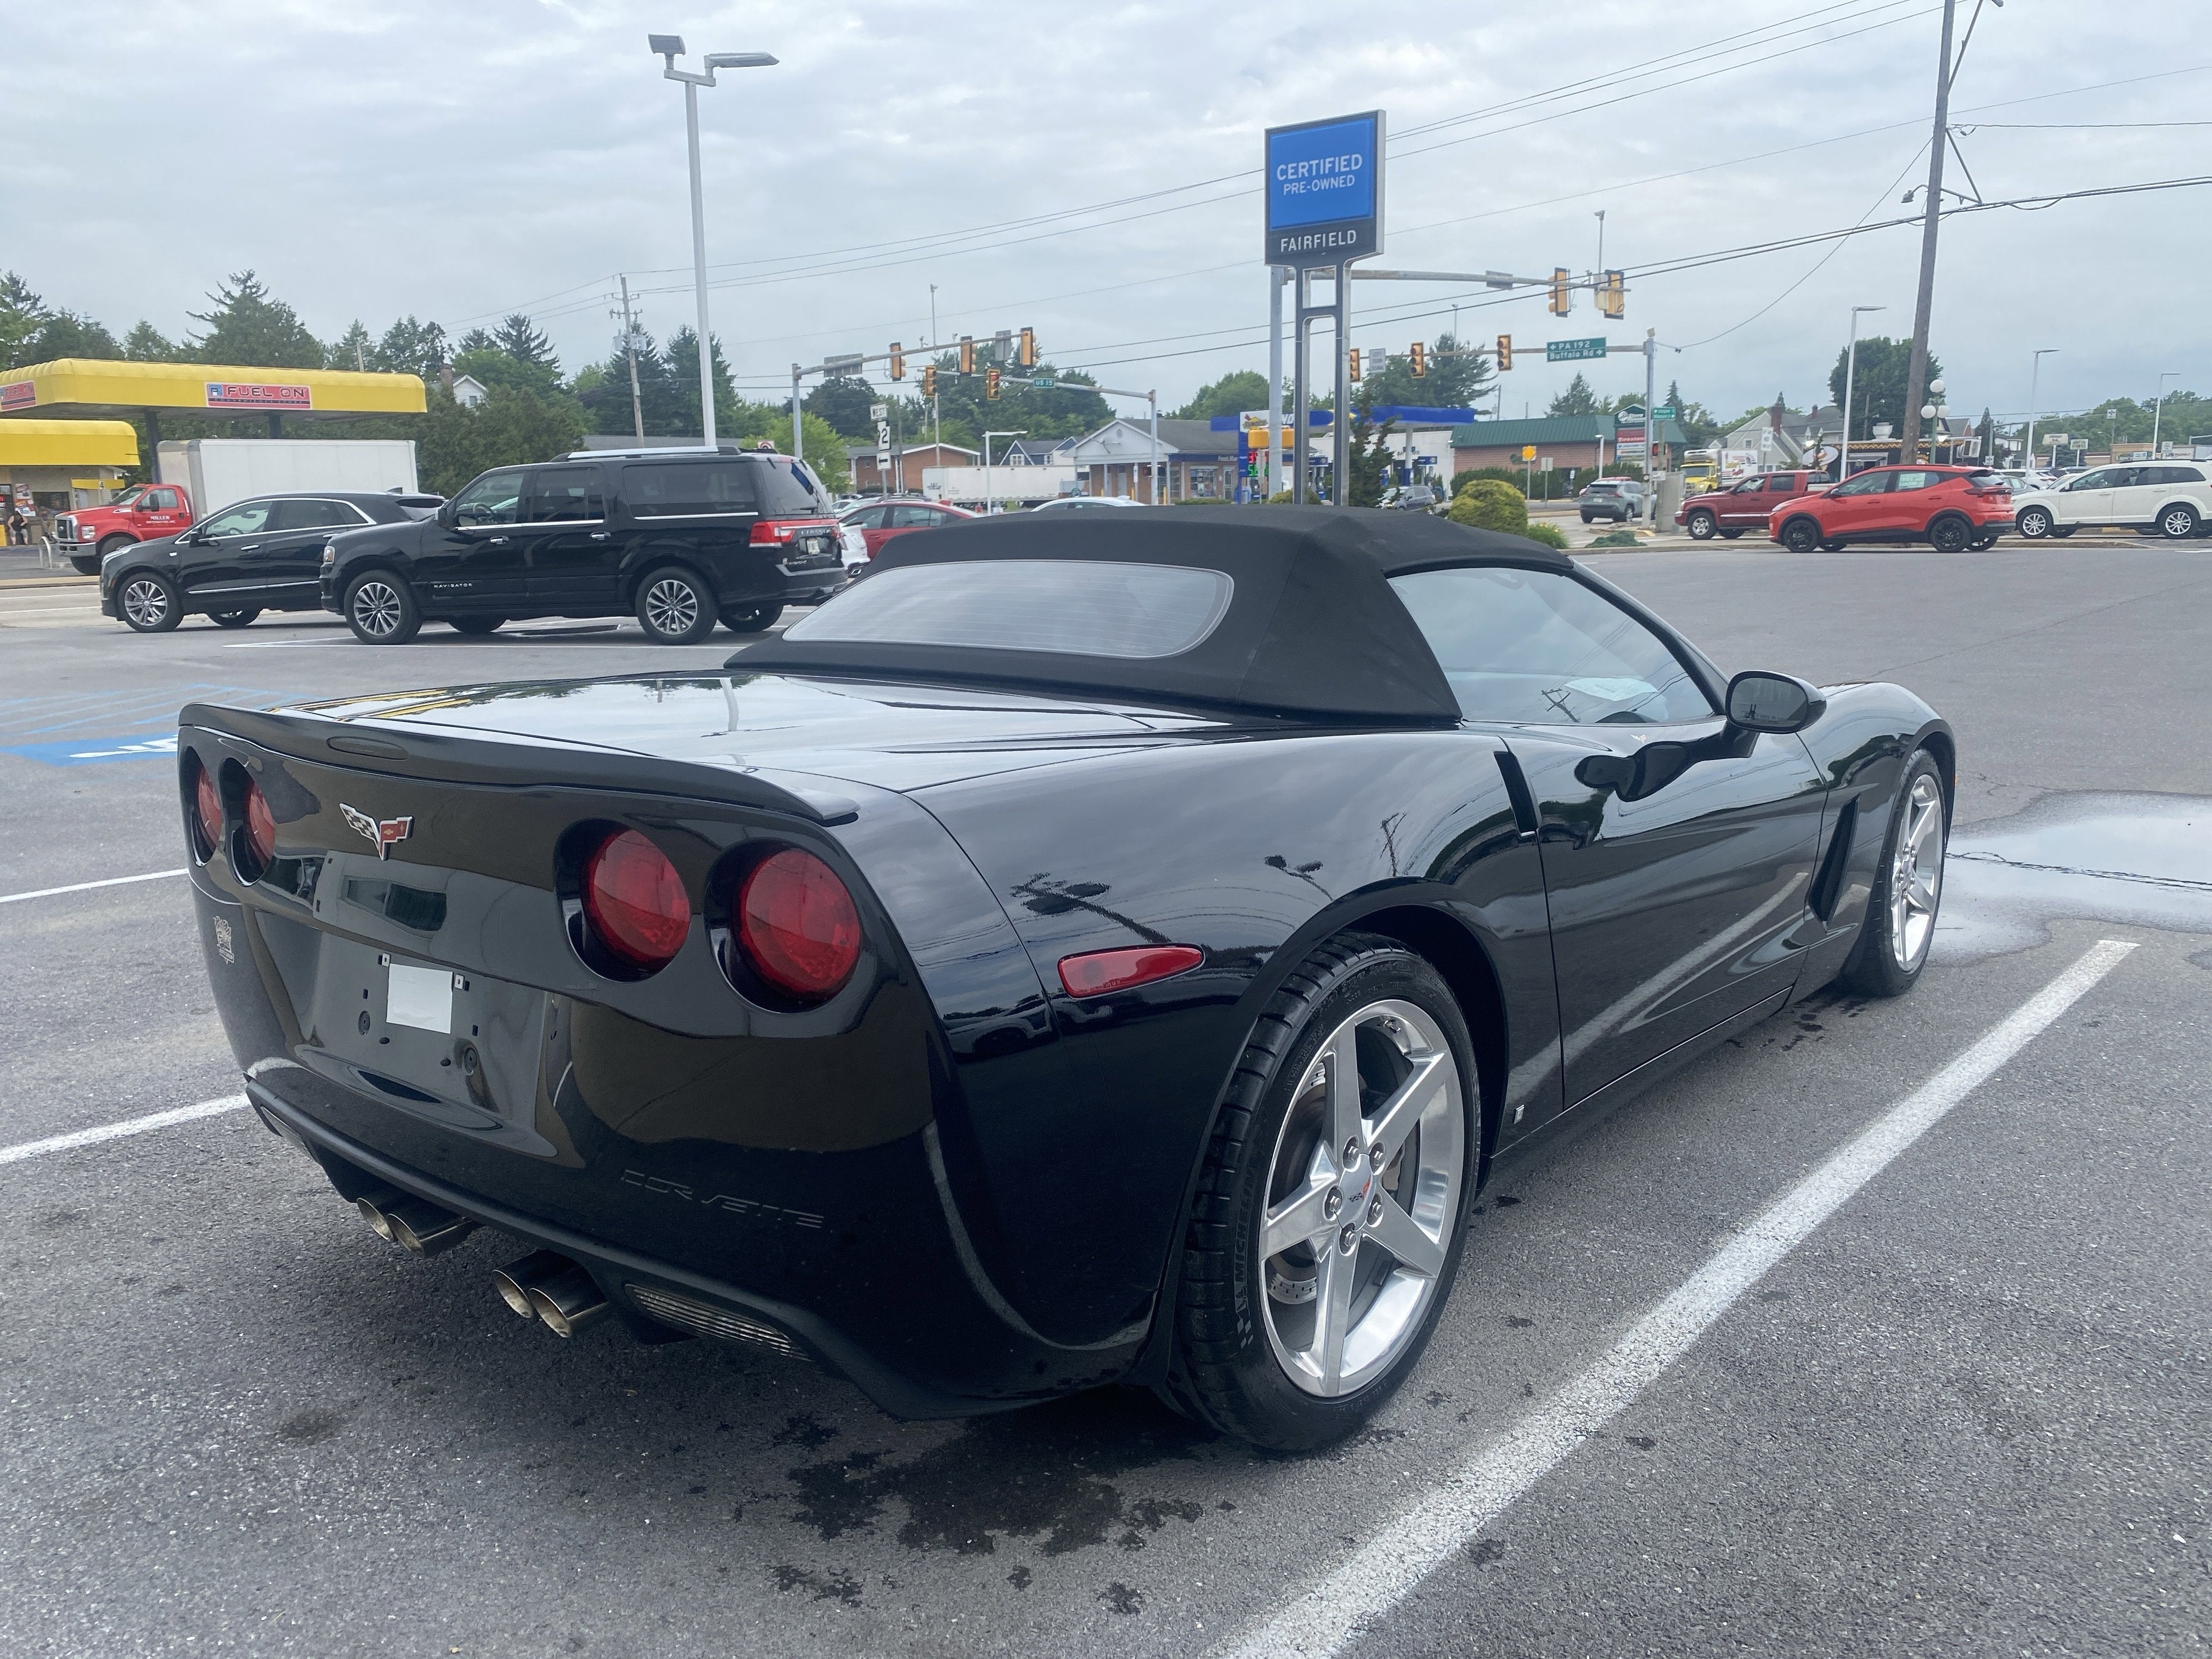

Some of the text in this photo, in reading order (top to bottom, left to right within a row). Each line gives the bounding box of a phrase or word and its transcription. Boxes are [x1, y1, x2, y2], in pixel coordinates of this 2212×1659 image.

[1276, 153, 1363, 181] CERTIFIED
[1283, 174, 1356, 196] PRE-OWNED
[1280, 229, 1357, 253] FAIRFIELD
[1573, 340, 1590, 349] 192
[1549, 352, 1581, 360] Buffalo
[227, 386, 304, 398] FUEL ON
[620, 1169, 824, 1229] CORVETTE
